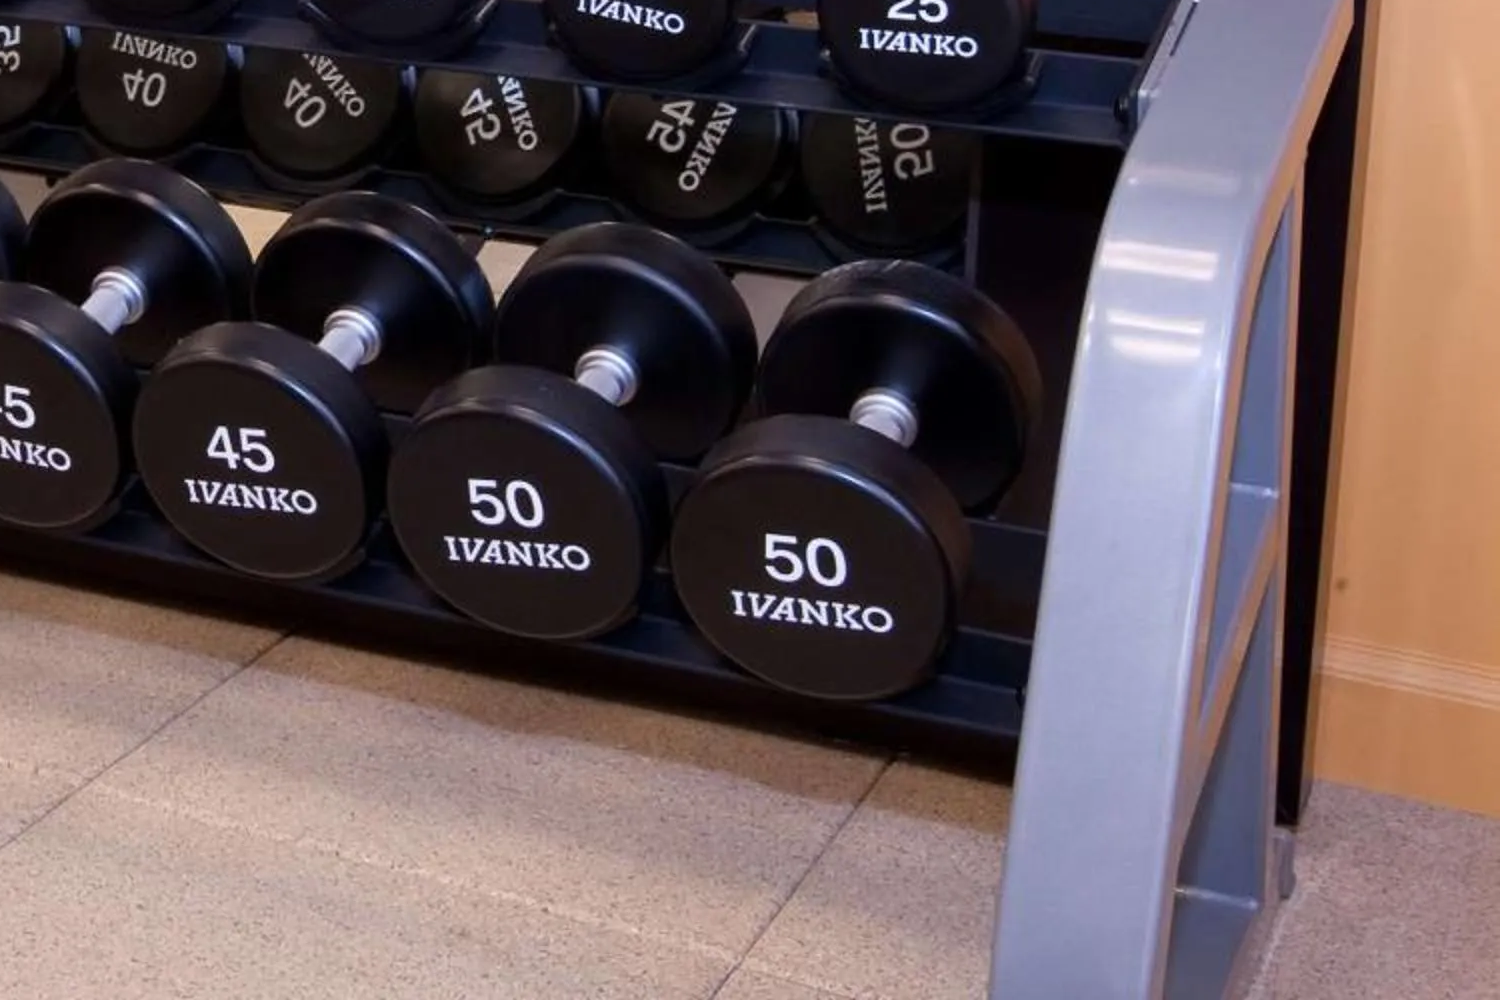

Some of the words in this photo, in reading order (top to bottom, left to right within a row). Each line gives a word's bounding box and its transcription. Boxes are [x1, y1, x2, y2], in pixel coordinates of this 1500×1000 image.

[859, 27, 979, 59] IVANKO
[206, 425, 275, 473] 45
[183, 478, 318, 515] IVANKO
[467, 478, 545, 529] 50
[443, 535, 591, 571] IVANKO
[764, 533, 847, 587] 50
[730, 589, 894, 633] IVANKO
